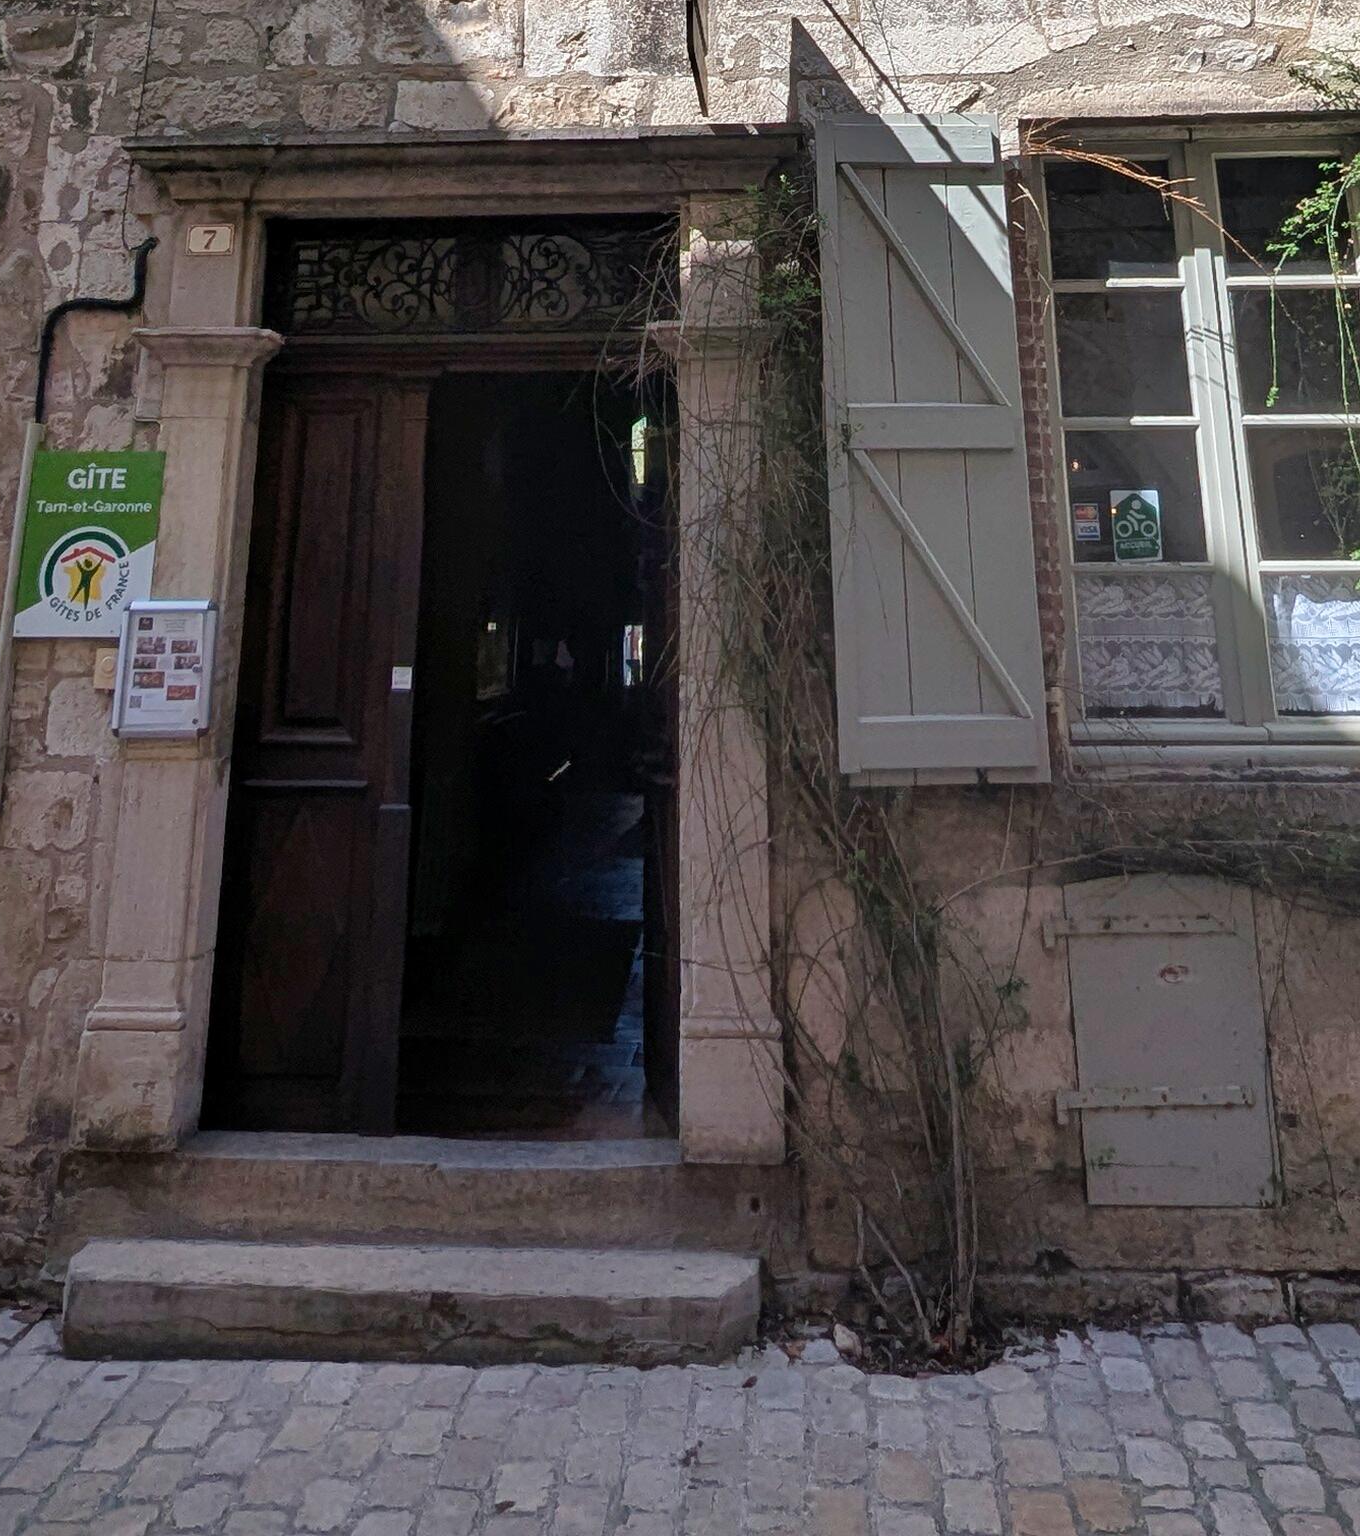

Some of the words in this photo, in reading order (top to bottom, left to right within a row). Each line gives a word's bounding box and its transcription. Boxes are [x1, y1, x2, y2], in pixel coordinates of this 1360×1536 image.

[203, 230, 217, 250] 7
[68, 462, 127, 490] GÎTE
[36, 499, 152, 514] Tarn-et-Garonne
[49, 597, 80, 622] GÎTES
[85, 607, 102, 622] DE
[105, 561, 130, 610] FRANCE
